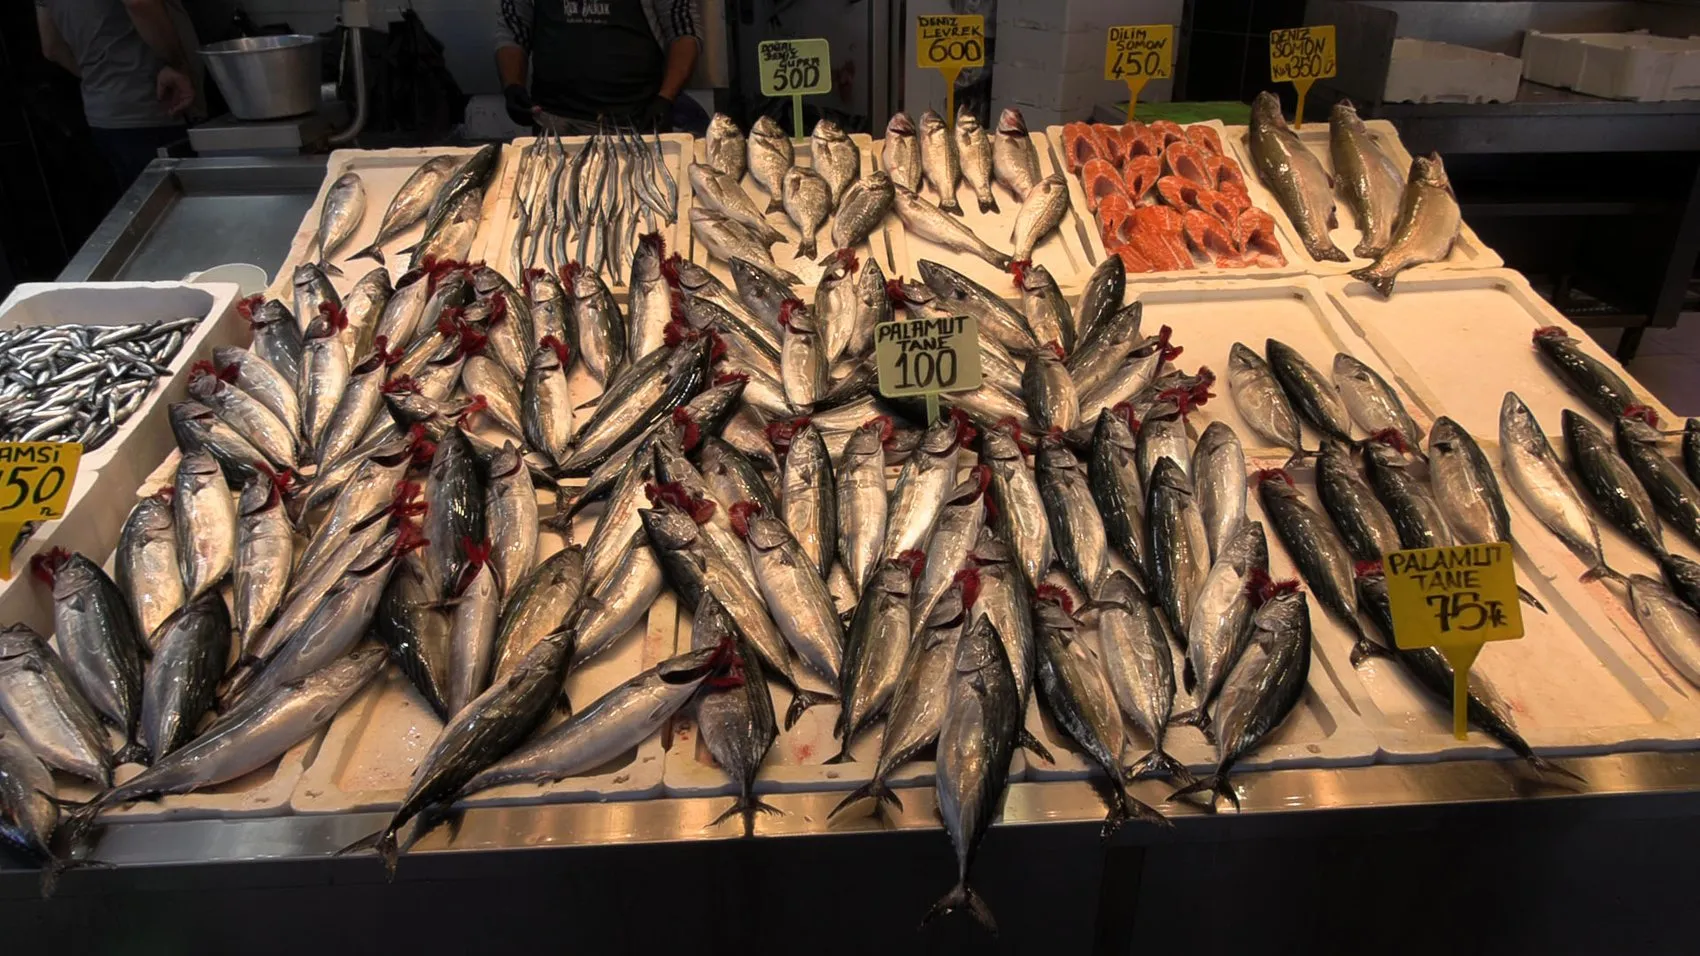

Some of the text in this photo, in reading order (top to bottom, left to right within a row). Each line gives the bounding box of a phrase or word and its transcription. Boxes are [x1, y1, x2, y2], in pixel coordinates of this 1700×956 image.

[923, 26, 984, 39] LEVREK
[1110, 28, 1147, 41] DİLİM
[928, 39, 982, 62] 600
[1116, 37, 1168, 52] SOMON
[1272, 36, 1326, 59] SOMON
[1111, 51, 1161, 79] 450
[878, 315, 970, 343] PALAMUT
[896, 335, 955, 352] TANE
[894, 348, 957, 389] 100
[1388, 546, 1504, 576] PALAMUT
[1409, 570, 1482, 592] TANE
